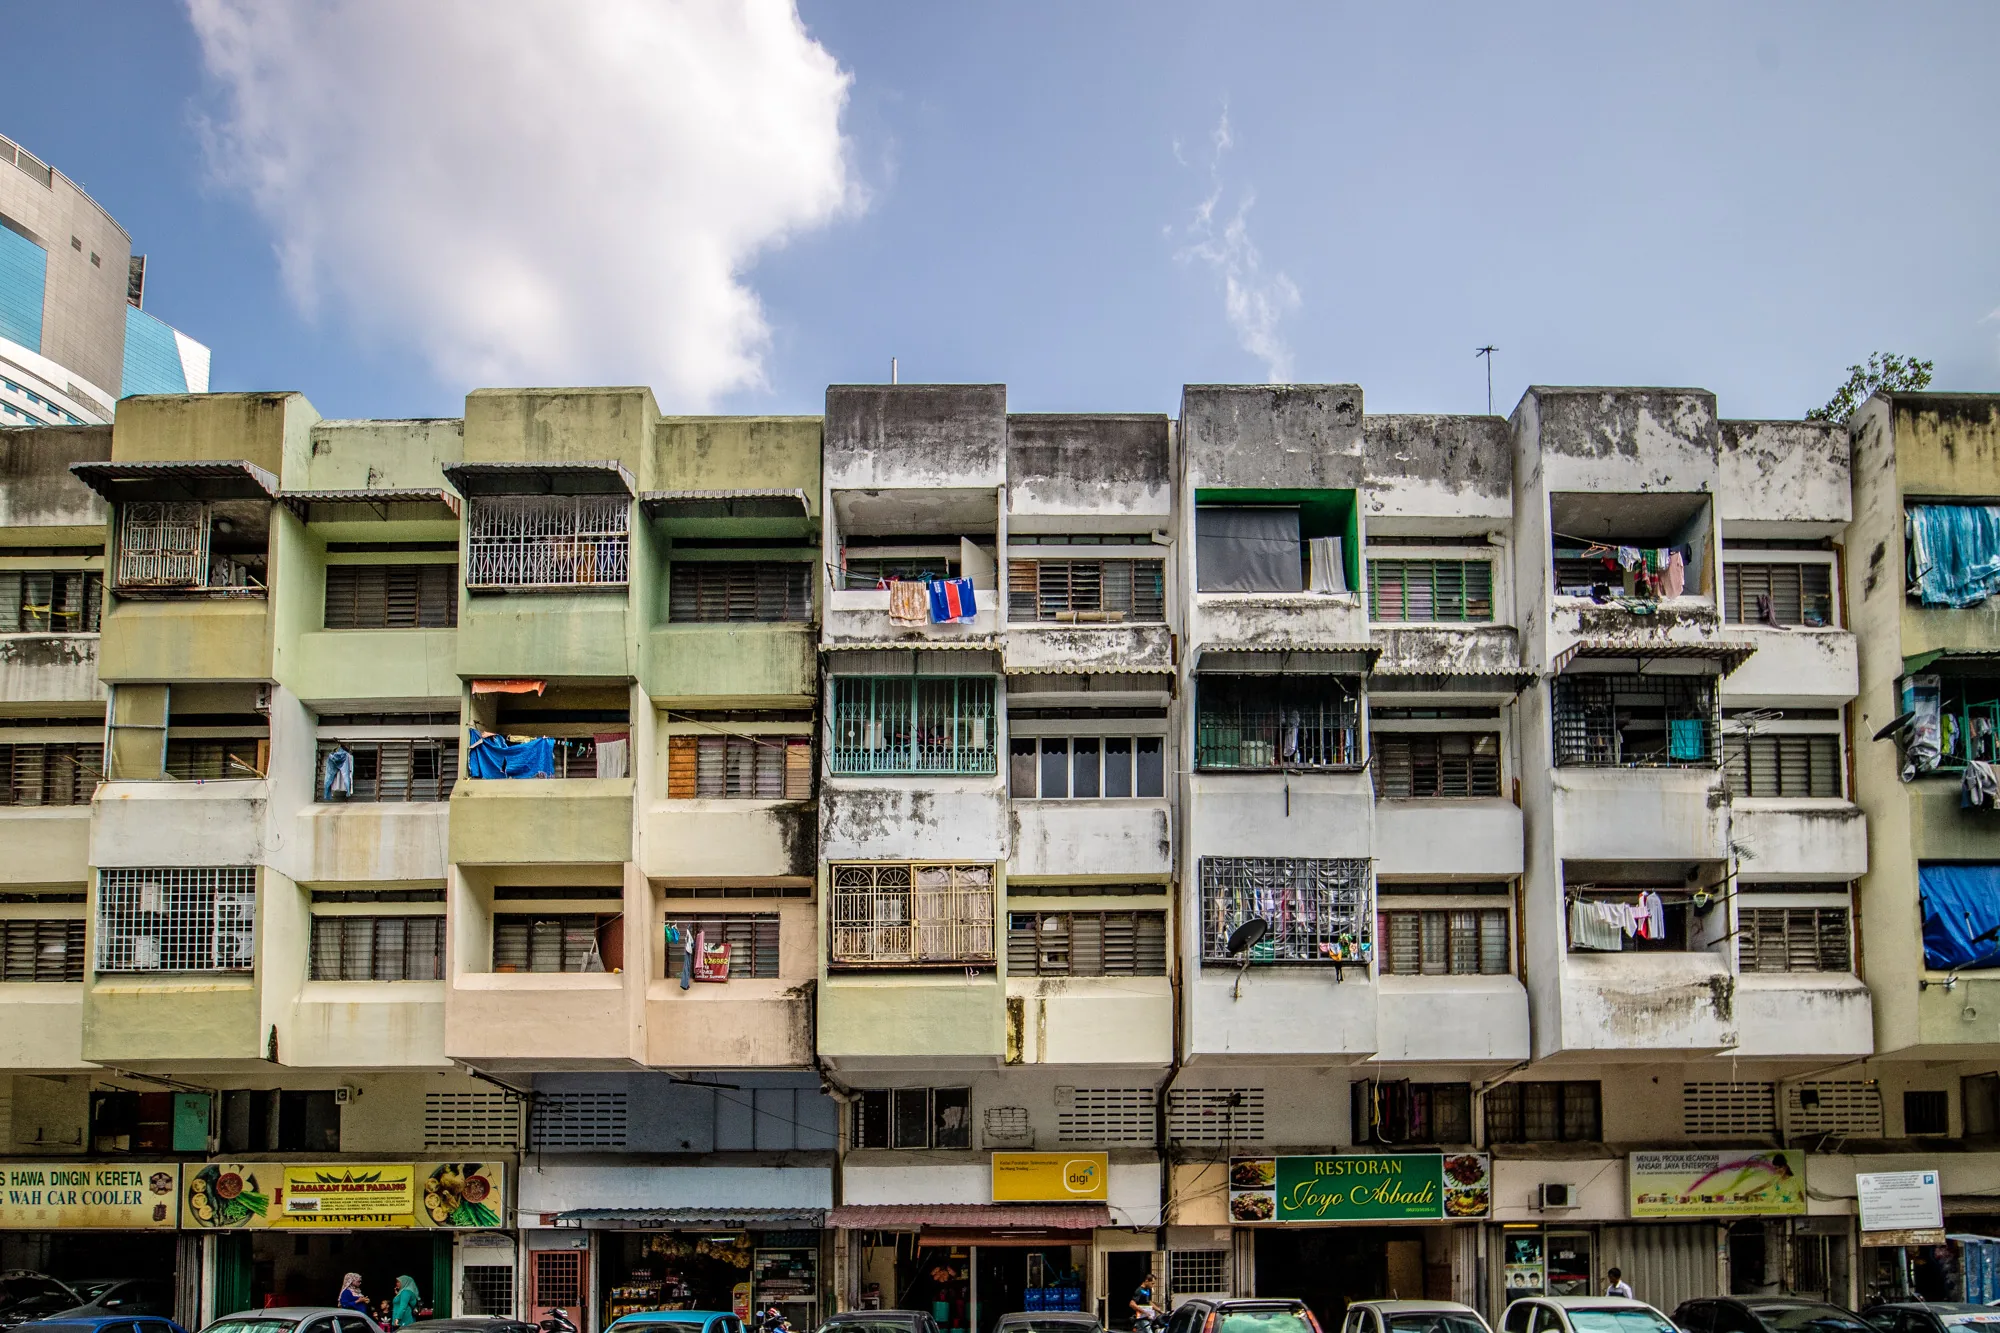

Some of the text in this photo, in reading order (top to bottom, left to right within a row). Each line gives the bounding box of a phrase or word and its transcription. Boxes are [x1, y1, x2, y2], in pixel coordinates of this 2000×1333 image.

[1315, 1160, 1402, 1175] RESTORAN
[11, 1171, 45, 1186] HAWA
[50, 1171, 90, 1186] DINGIN
[96, 1171, 143, 1186] KERETA
[1069, 1173, 1088, 1185] digi
[290, 1183, 407, 1192] MASAKAN NASI PADANG
[1350, 1177, 1437, 1205] Abadi
[9, 1190, 42, 1205] WAH
[47, 1190, 78, 1205] CAR
[82, 1190, 143, 1205] COOLER
